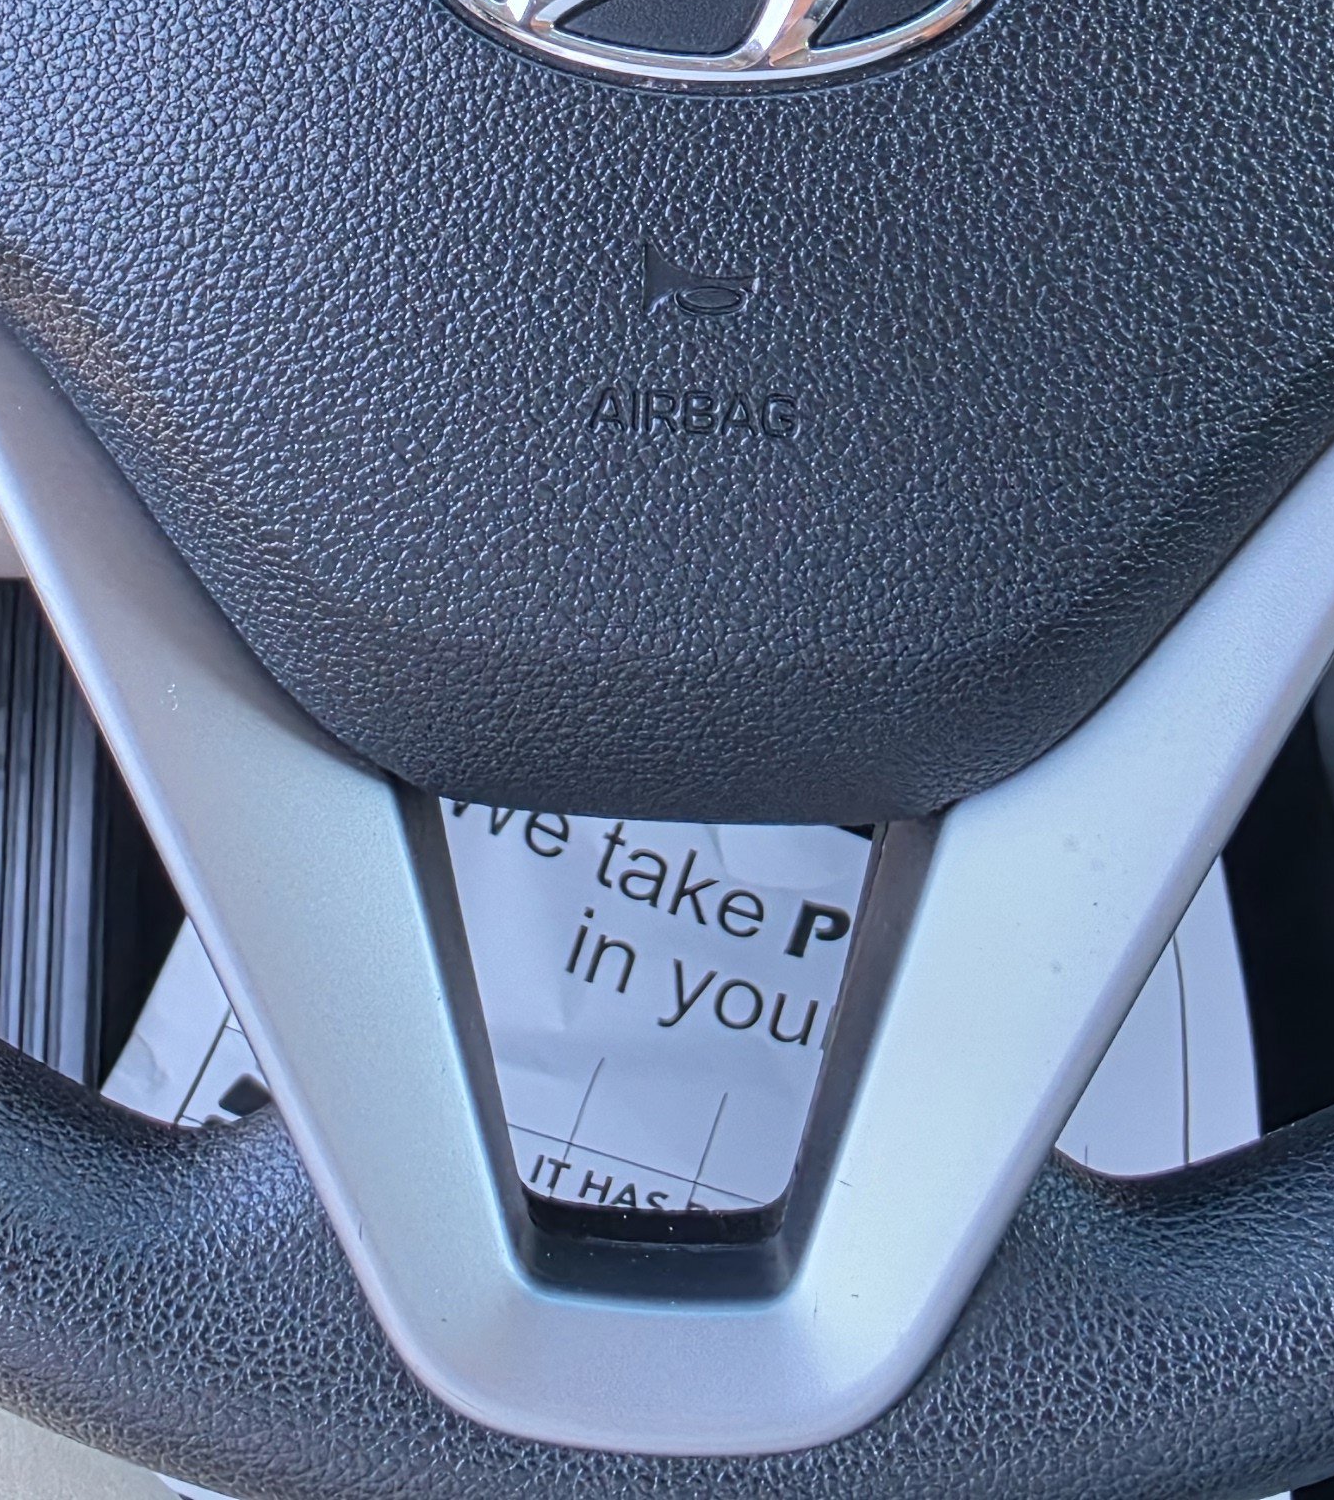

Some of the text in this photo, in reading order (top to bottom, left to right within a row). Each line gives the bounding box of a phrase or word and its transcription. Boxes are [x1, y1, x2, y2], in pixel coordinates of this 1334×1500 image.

[589, 386, 801, 438] AIRBAG
[595, 821, 765, 938] take
[565, 907, 819, 1046] in you
[529, 1154, 571, 1189] IT
